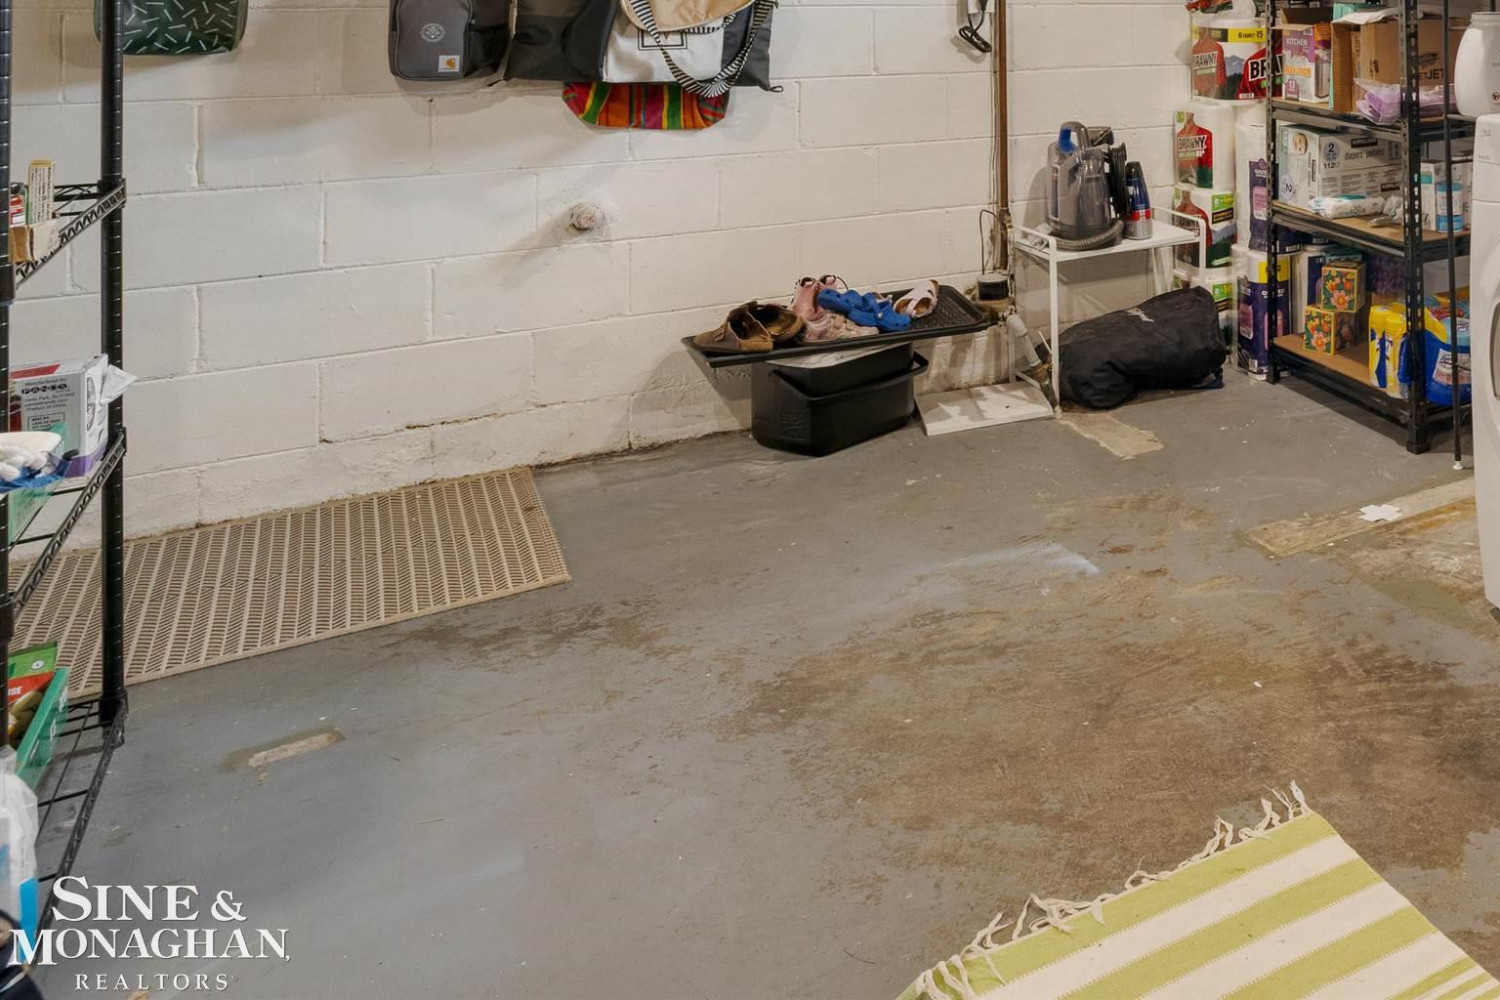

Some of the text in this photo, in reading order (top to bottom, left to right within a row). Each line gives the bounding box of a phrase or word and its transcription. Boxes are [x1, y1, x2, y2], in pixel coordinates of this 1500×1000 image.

[1286, 37, 1308, 46] KITCHEN
[1418, 68, 1444, 80] ETJET
[1328, 143, 1335, 153] 2
